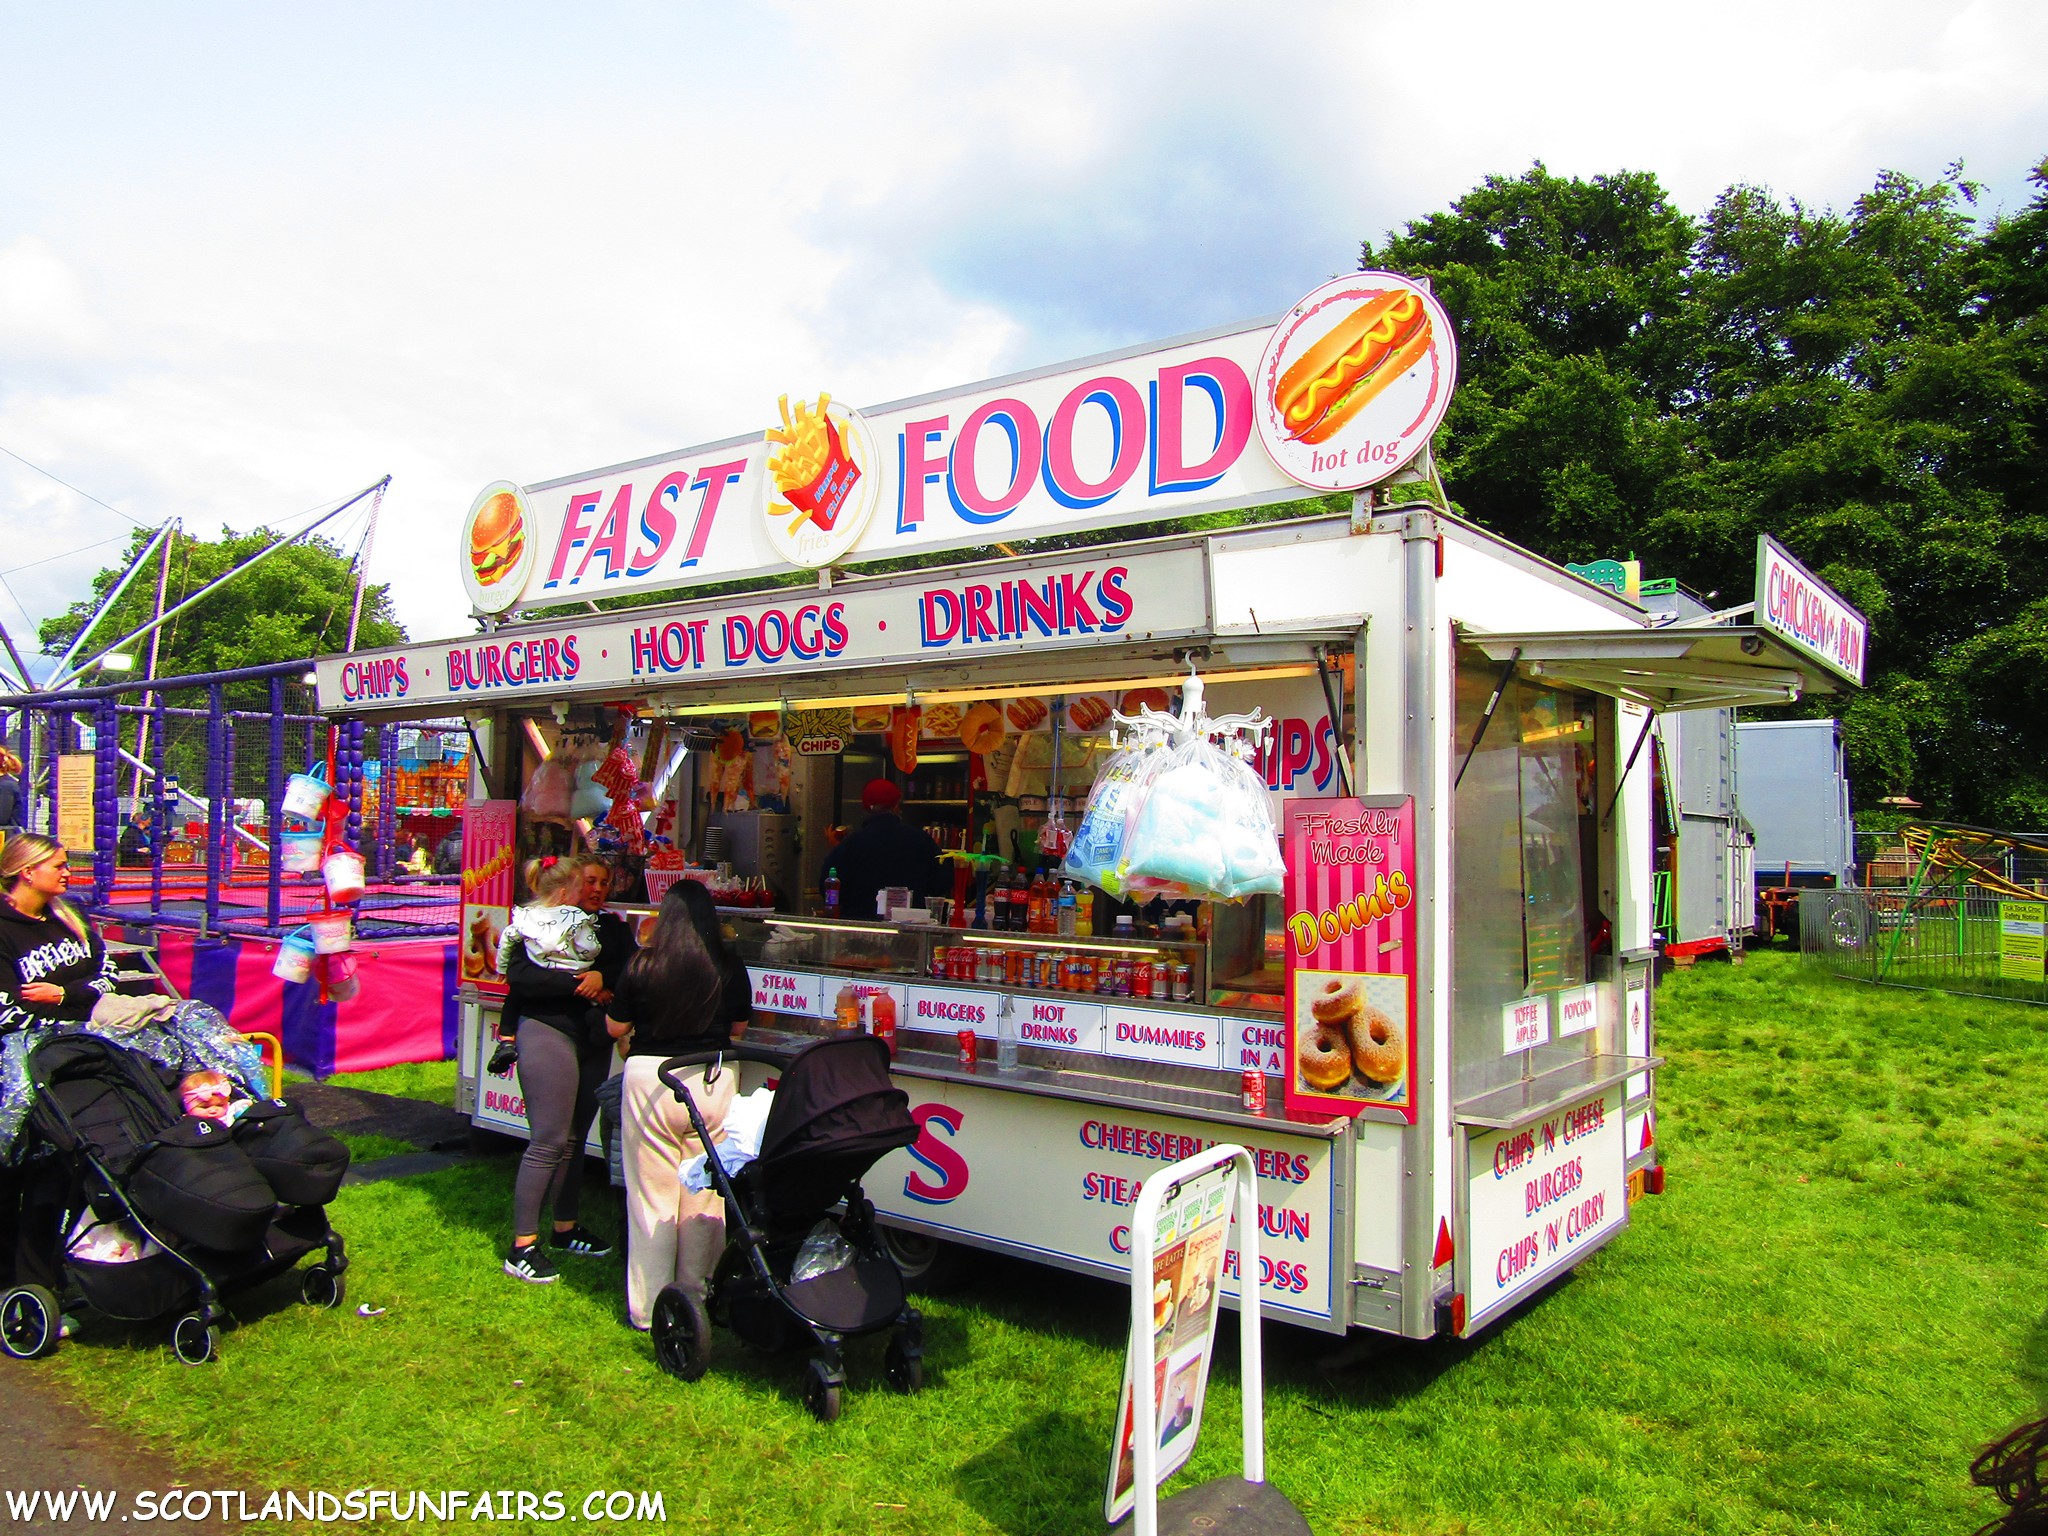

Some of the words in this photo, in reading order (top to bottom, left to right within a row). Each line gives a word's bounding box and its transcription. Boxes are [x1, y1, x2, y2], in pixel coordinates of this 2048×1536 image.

[1311, 448, 1348, 473] hot
[1357, 440, 1400, 465] dog
[543, 458, 748, 589] FAST
[895, 356, 1253, 535] FOOD
[797, 533, 831, 557] fries
[478, 588, 509, 605] burger
[1768, 561, 1827, 654] CHICKEN
[1838, 616, 1861, 675] BUN
[340, 656, 410, 702] CHIPS
[447, 634, 581, 692] BURGERS
[631, 619, 709, 675] HOT
[724, 601, 849, 667] DOGS
[919, 565, 1134, 648] DRINKS
[801, 739, 840, 752] CHIPS
[1238, 714, 1334, 792] IPS
[1294, 809, 1400, 843] Freshly
[1311, 839, 1384, 866] Made
[461, 843, 514, 897] Donuts
[1287, 868, 1413, 958] Donuts
[2004, 912, 2021, 920] Safety
[762, 974, 797, 991] STEAK
[851, 984, 882, 1000] HIPS
[754, 989, 768, 1006] IN
[769, 992, 779, 1007] A
[783, 994, 807, 1011] BUN
[917, 999, 986, 1024] BURGERS
[1563, 998, 1592, 1021] POPCORN
[1032, 1004, 1065, 1023] HOT
[1514, 1004, 1538, 1026] TOFFEE
[1021, 1022, 1078, 1045] DRINKS
[1116, 1022, 1206, 1050] DUMMIES
[1515, 1024, 1539, 1046] APPLES
[1240, 1048, 1260, 1067] IN
[1266, 1052, 1281, 1070] A
[1080, 1120, 1310, 1184] CHEESEBERS
[1493, 1128, 1536, 1181] CHIPS
[1563, 1097, 1605, 1146] CHEESE
[1524, 1155, 1583, 1218] BURGERS
[1188, 1230, 1223, 1260] Espresso
[1496, 1230, 1539, 1288] CHIPS
[1565, 1189, 1605, 1243] CURRY
[1165, 1247, 1185, 1267] LATTE
